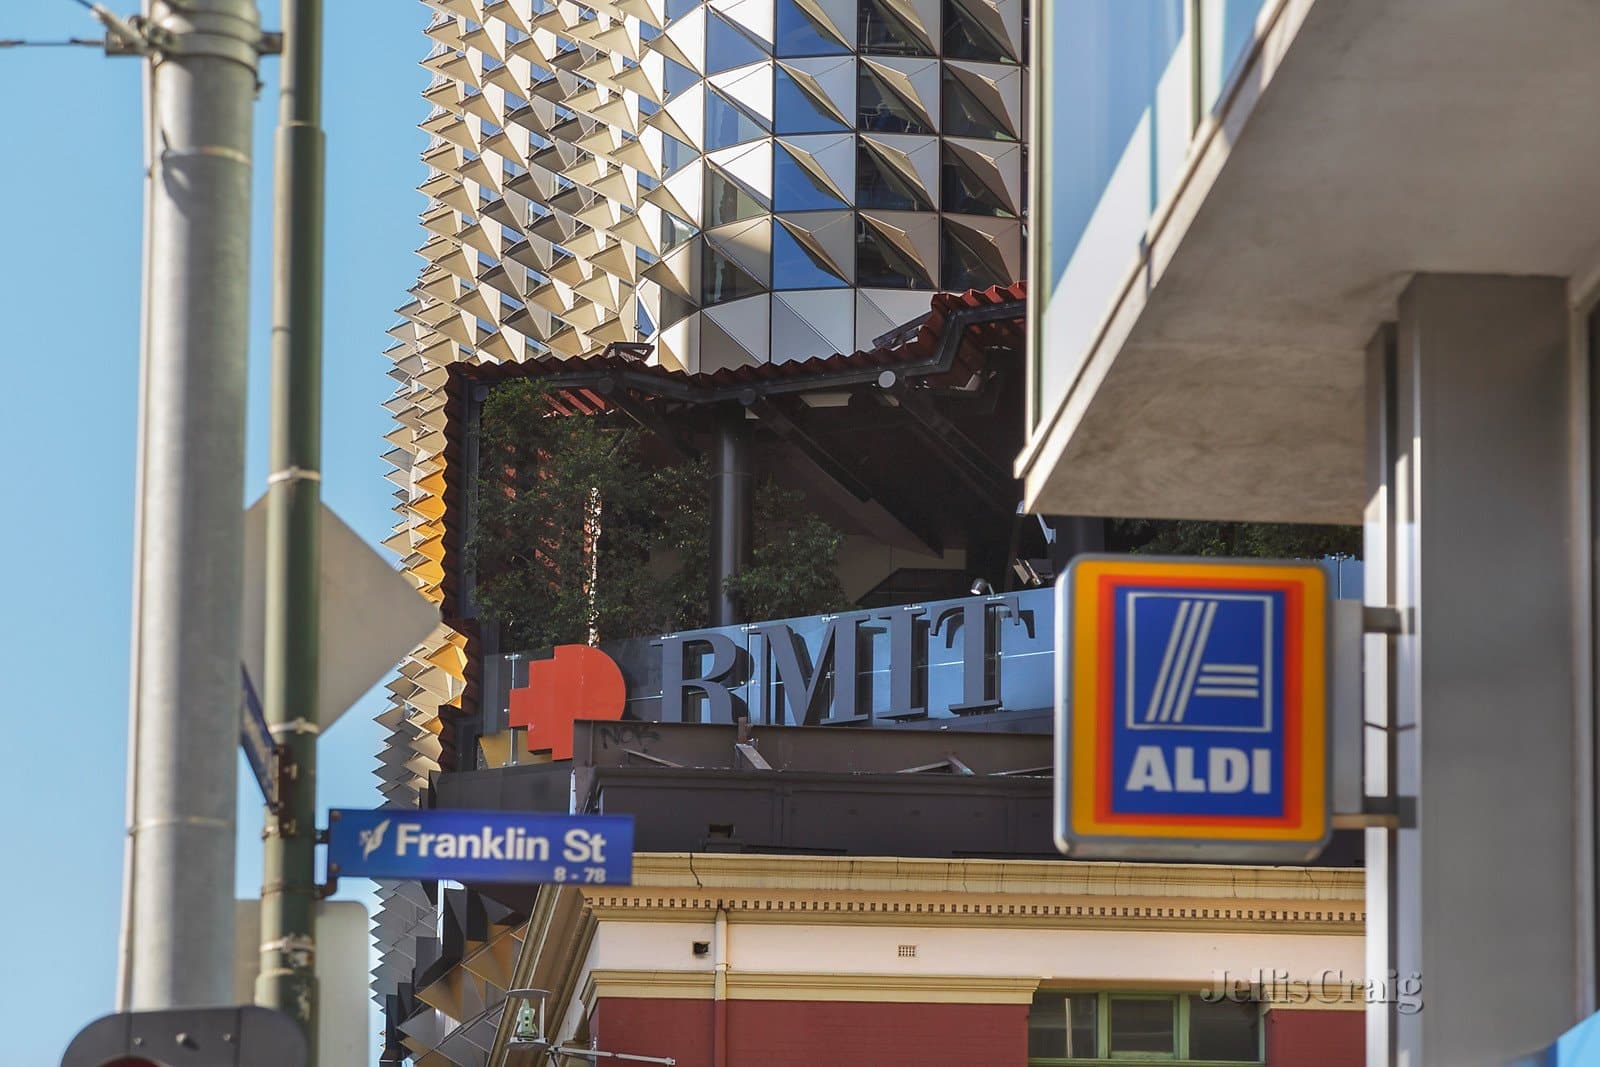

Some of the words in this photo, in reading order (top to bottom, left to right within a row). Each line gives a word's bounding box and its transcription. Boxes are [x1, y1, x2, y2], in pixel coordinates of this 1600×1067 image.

[650, 596, 1036, 725] RMIT
[1125, 745, 1272, 795] ALDI
[395, 823, 549, 862] Franklin
[563, 829, 606, 863] St
